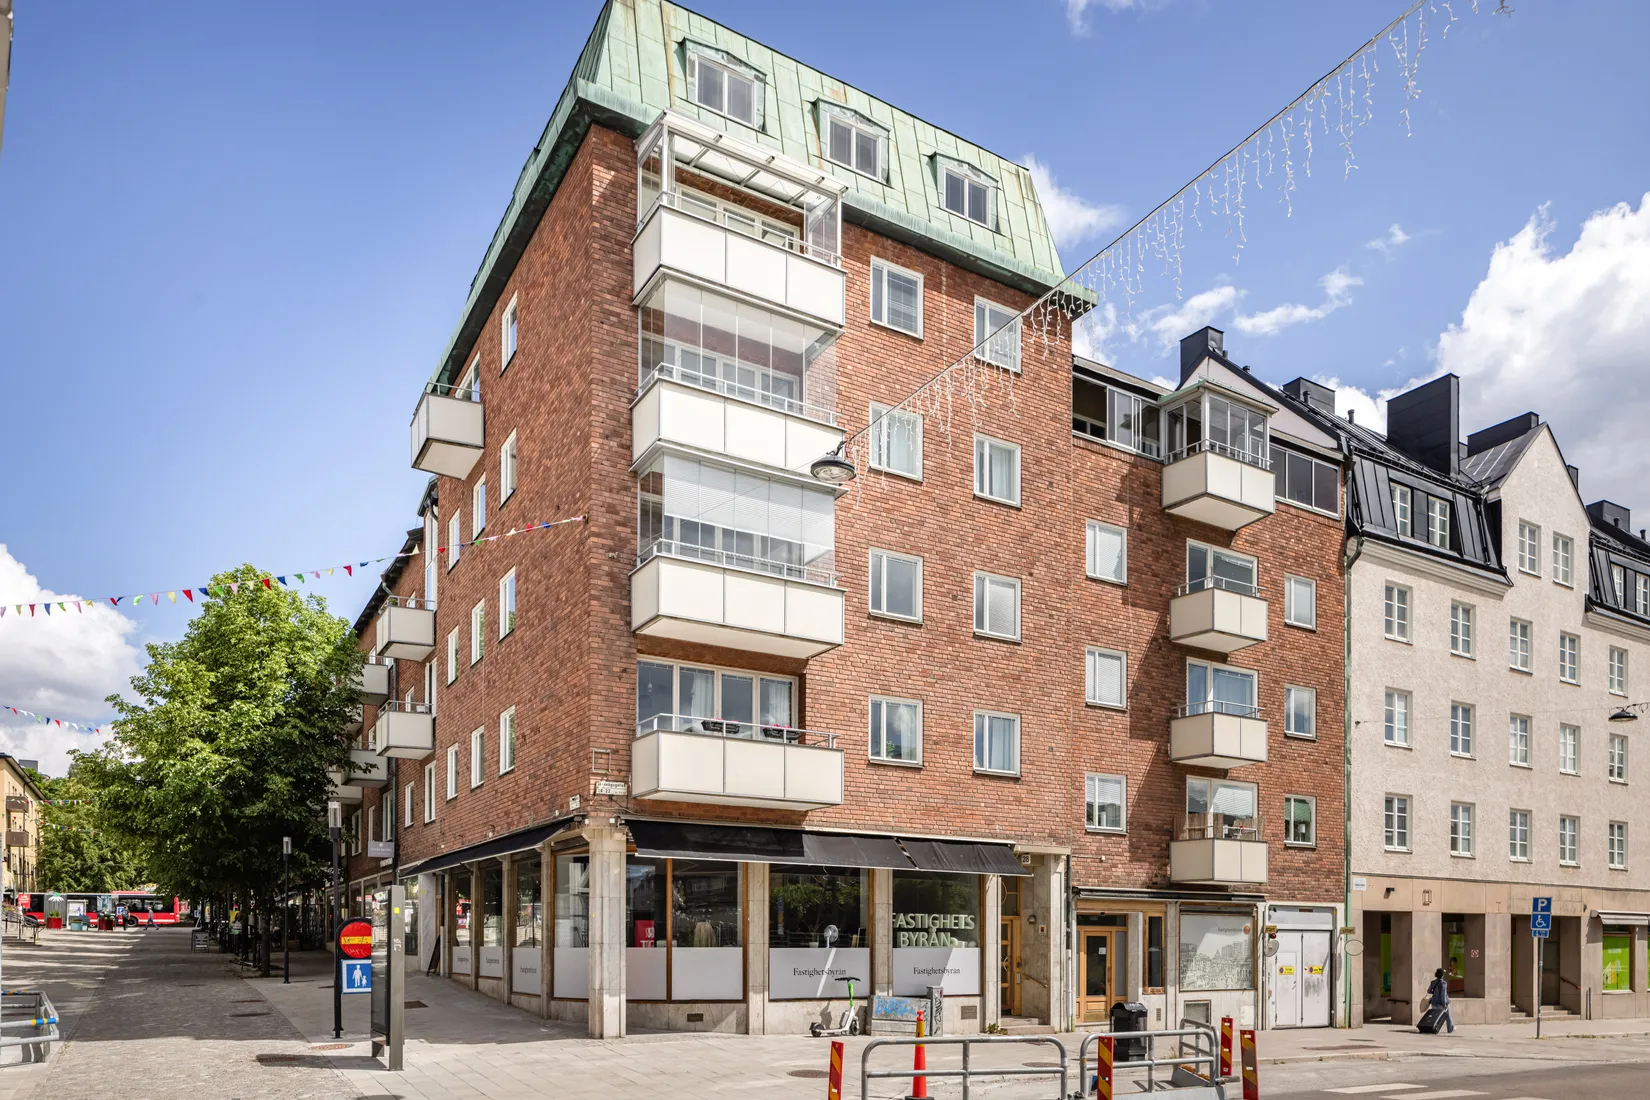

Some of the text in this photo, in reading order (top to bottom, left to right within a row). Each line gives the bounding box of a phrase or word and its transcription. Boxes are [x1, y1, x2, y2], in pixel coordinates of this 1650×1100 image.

[1022, 855, 1029, 863] 28
[1538, 899, 1547, 911] P
[900, 928, 951, 947] BYRÅN
[793, 967, 846, 977] Fastighetsbyrån
